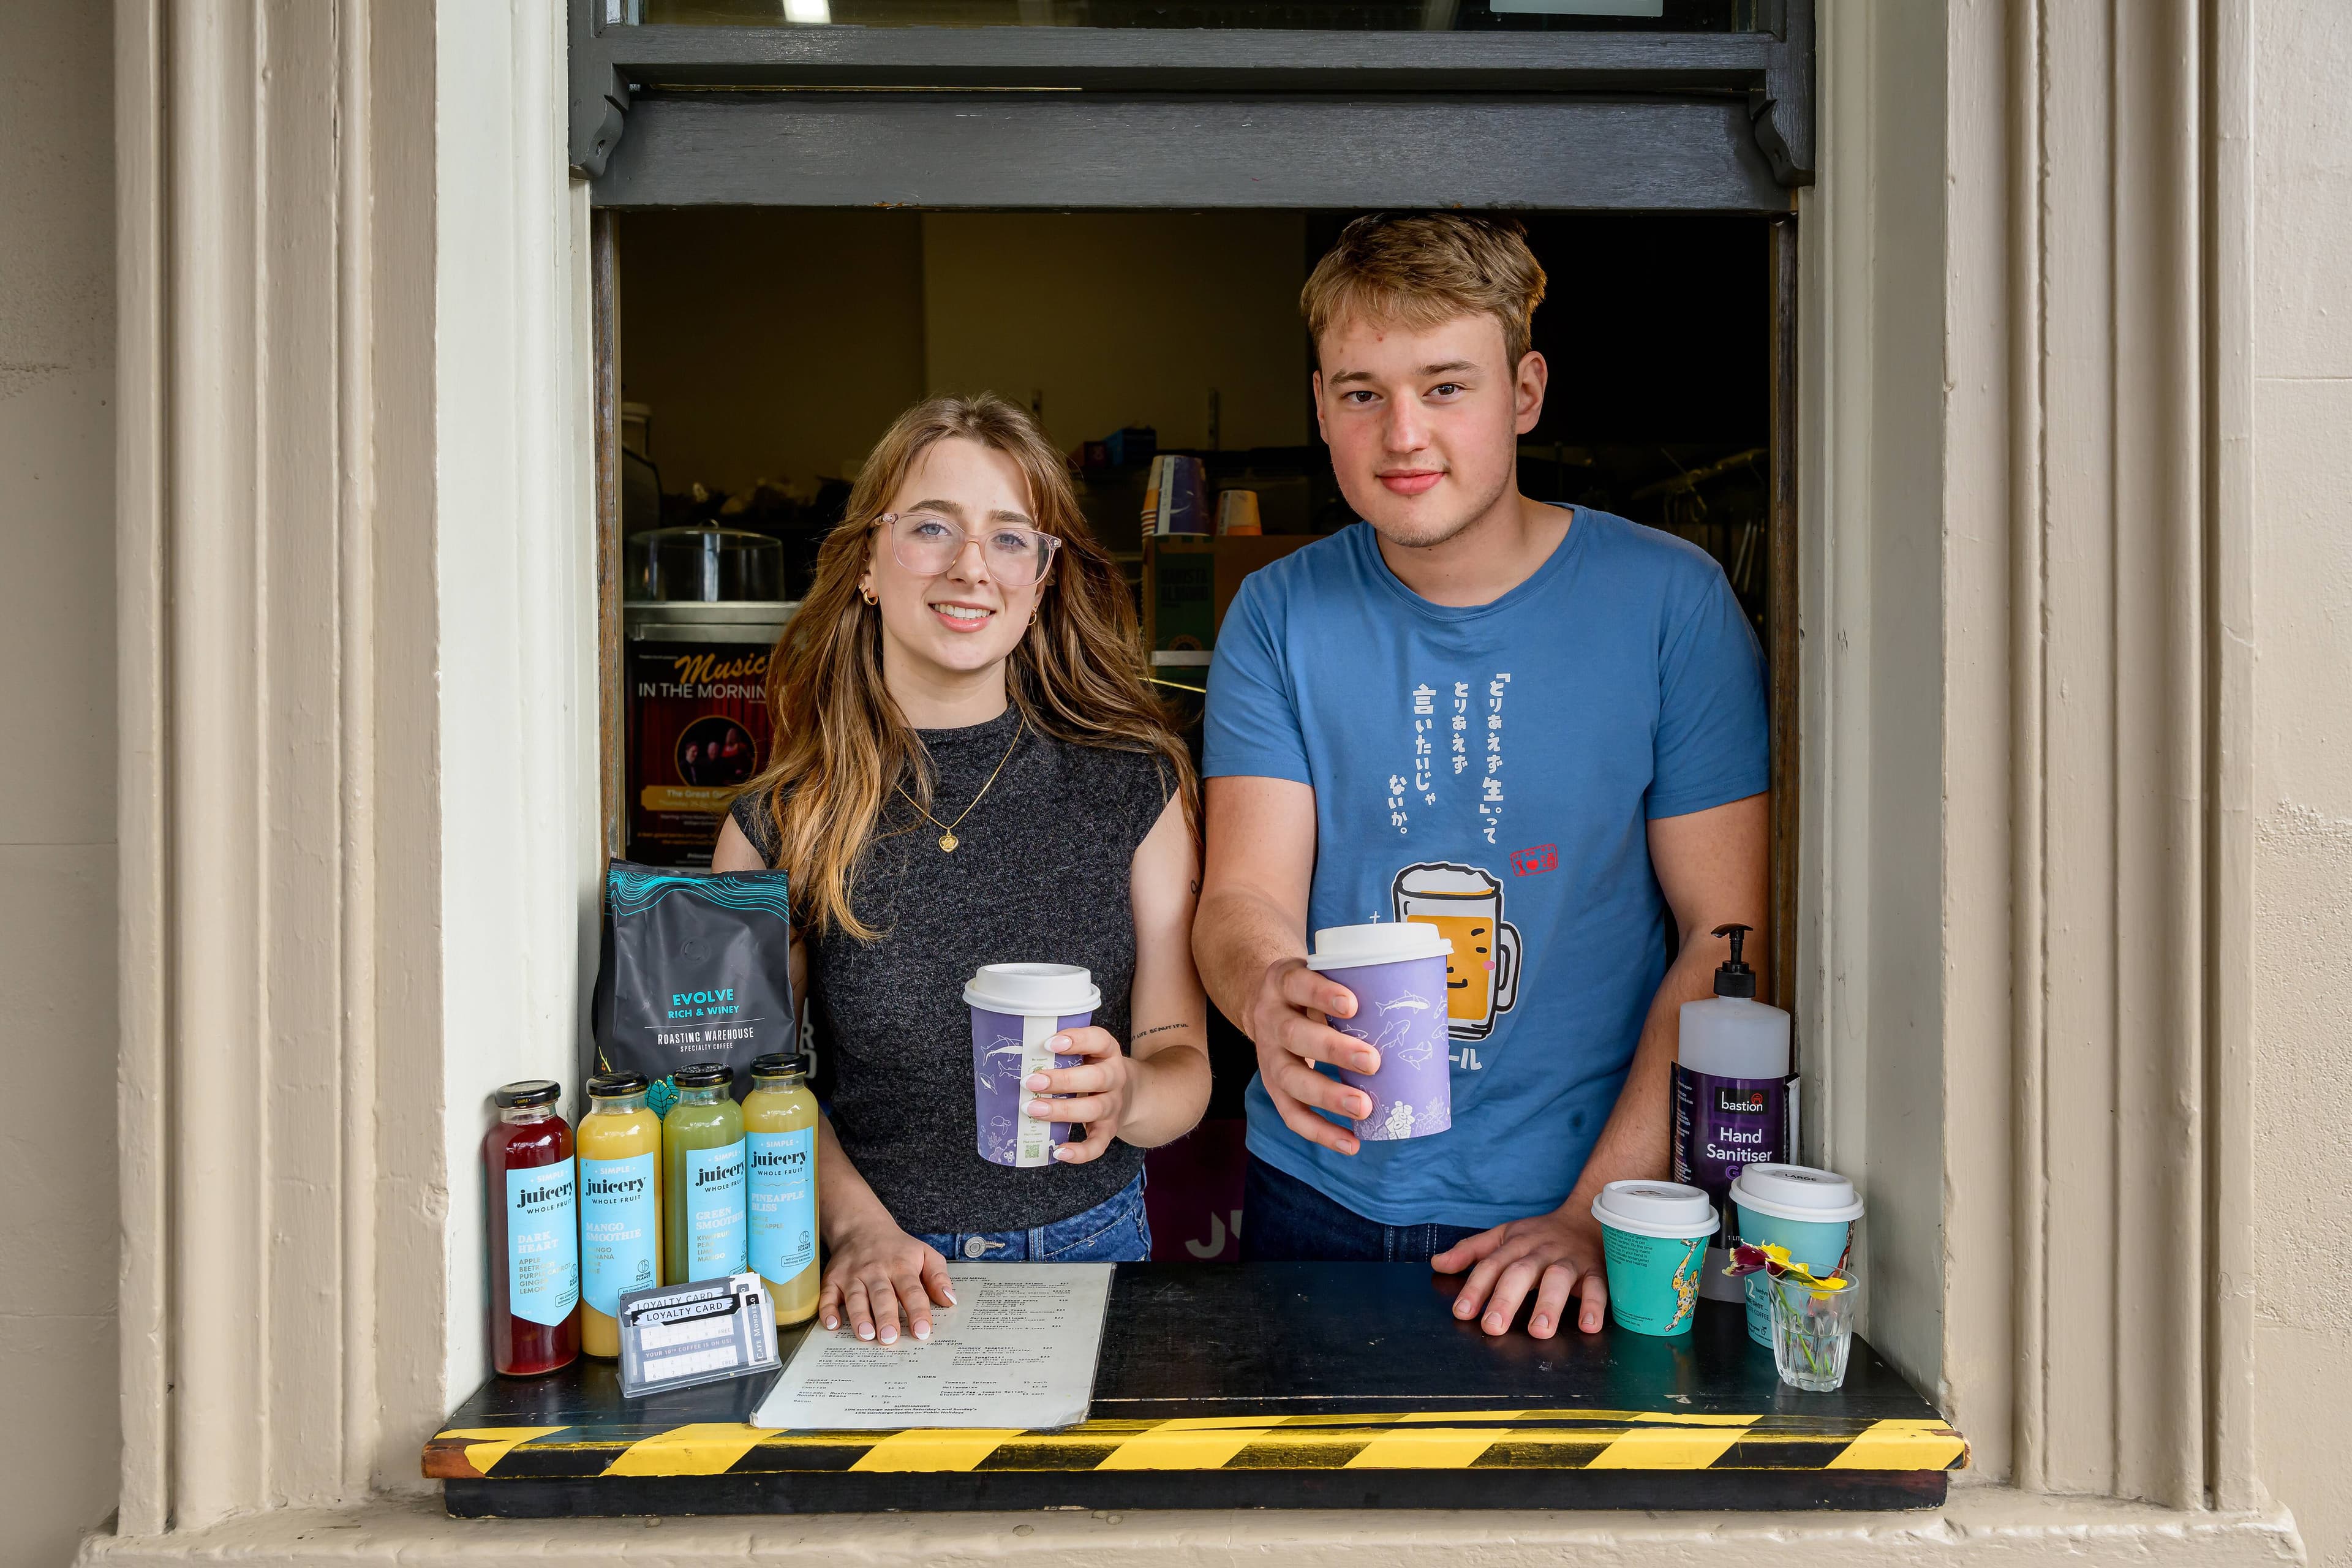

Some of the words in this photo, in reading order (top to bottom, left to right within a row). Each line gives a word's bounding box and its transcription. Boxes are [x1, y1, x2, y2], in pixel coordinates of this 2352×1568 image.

[674, 652, 766, 684] Music
[639, 683, 655, 697] IN
[660, 683, 692, 698] THE
[698, 684, 766, 699] MORNIN
[1452, 681, 1469, 775] とりあえず
[1412, 683, 1436, 806] 言いたいじゃ
[1388, 774, 1408, 835] ないか。
[673, 989, 734, 1006] EVOLVE
[668, 1009, 692, 1019] RICH
[696, 1008, 704, 1017] &
[707, 1005, 740, 1015] WINEY
[658, 1031, 701, 1045] ROASTING
[704, 1027, 754, 1042] WAREHOUSE
[680, 1044, 710, 1052] SPECIALTY
[1722, 1091, 1763, 1112] bastion
[1720, 1127, 1762, 1144] Hand
[766, 1139, 794, 1148] SIMPLE
[714, 1150, 738, 1162] SIMPLE
[751, 1150, 808, 1169] juicery
[1706, 1144, 1773, 1162] Sanitiser
[537, 1170, 564, 1183] SIMPLE
[600, 1166, 630, 1175] SIMPLE
[695, 1160, 745, 1186] juicery
[1784, 1173, 1817, 1182] LARGE
[516, 1180, 574, 1208] juicery
[586, 1176, 647, 1197] juicery
[704, 1183, 729, 1193] WHOLE
[752, 1190, 804, 1202] PINEAPPLE
[527, 1205, 554, 1214] WHOLE
[557, 1198, 571, 1208] FRUIT
[696, 1206, 731, 1220] GREEN
[752, 1201, 777, 1212] BLISS
[586, 1222, 624, 1232] MANGO
[518, 1231, 551, 1243] DARK
[586, 1229, 642, 1242] SMOOTHIE
[518, 1239, 559, 1254] HEART
[686, 1292, 713, 1303] CARD
[647, 1307, 692, 1322] LOYALTY
[696, 1302, 723, 1313] CARD
[678, 1343, 701, 1352] COFFEE
